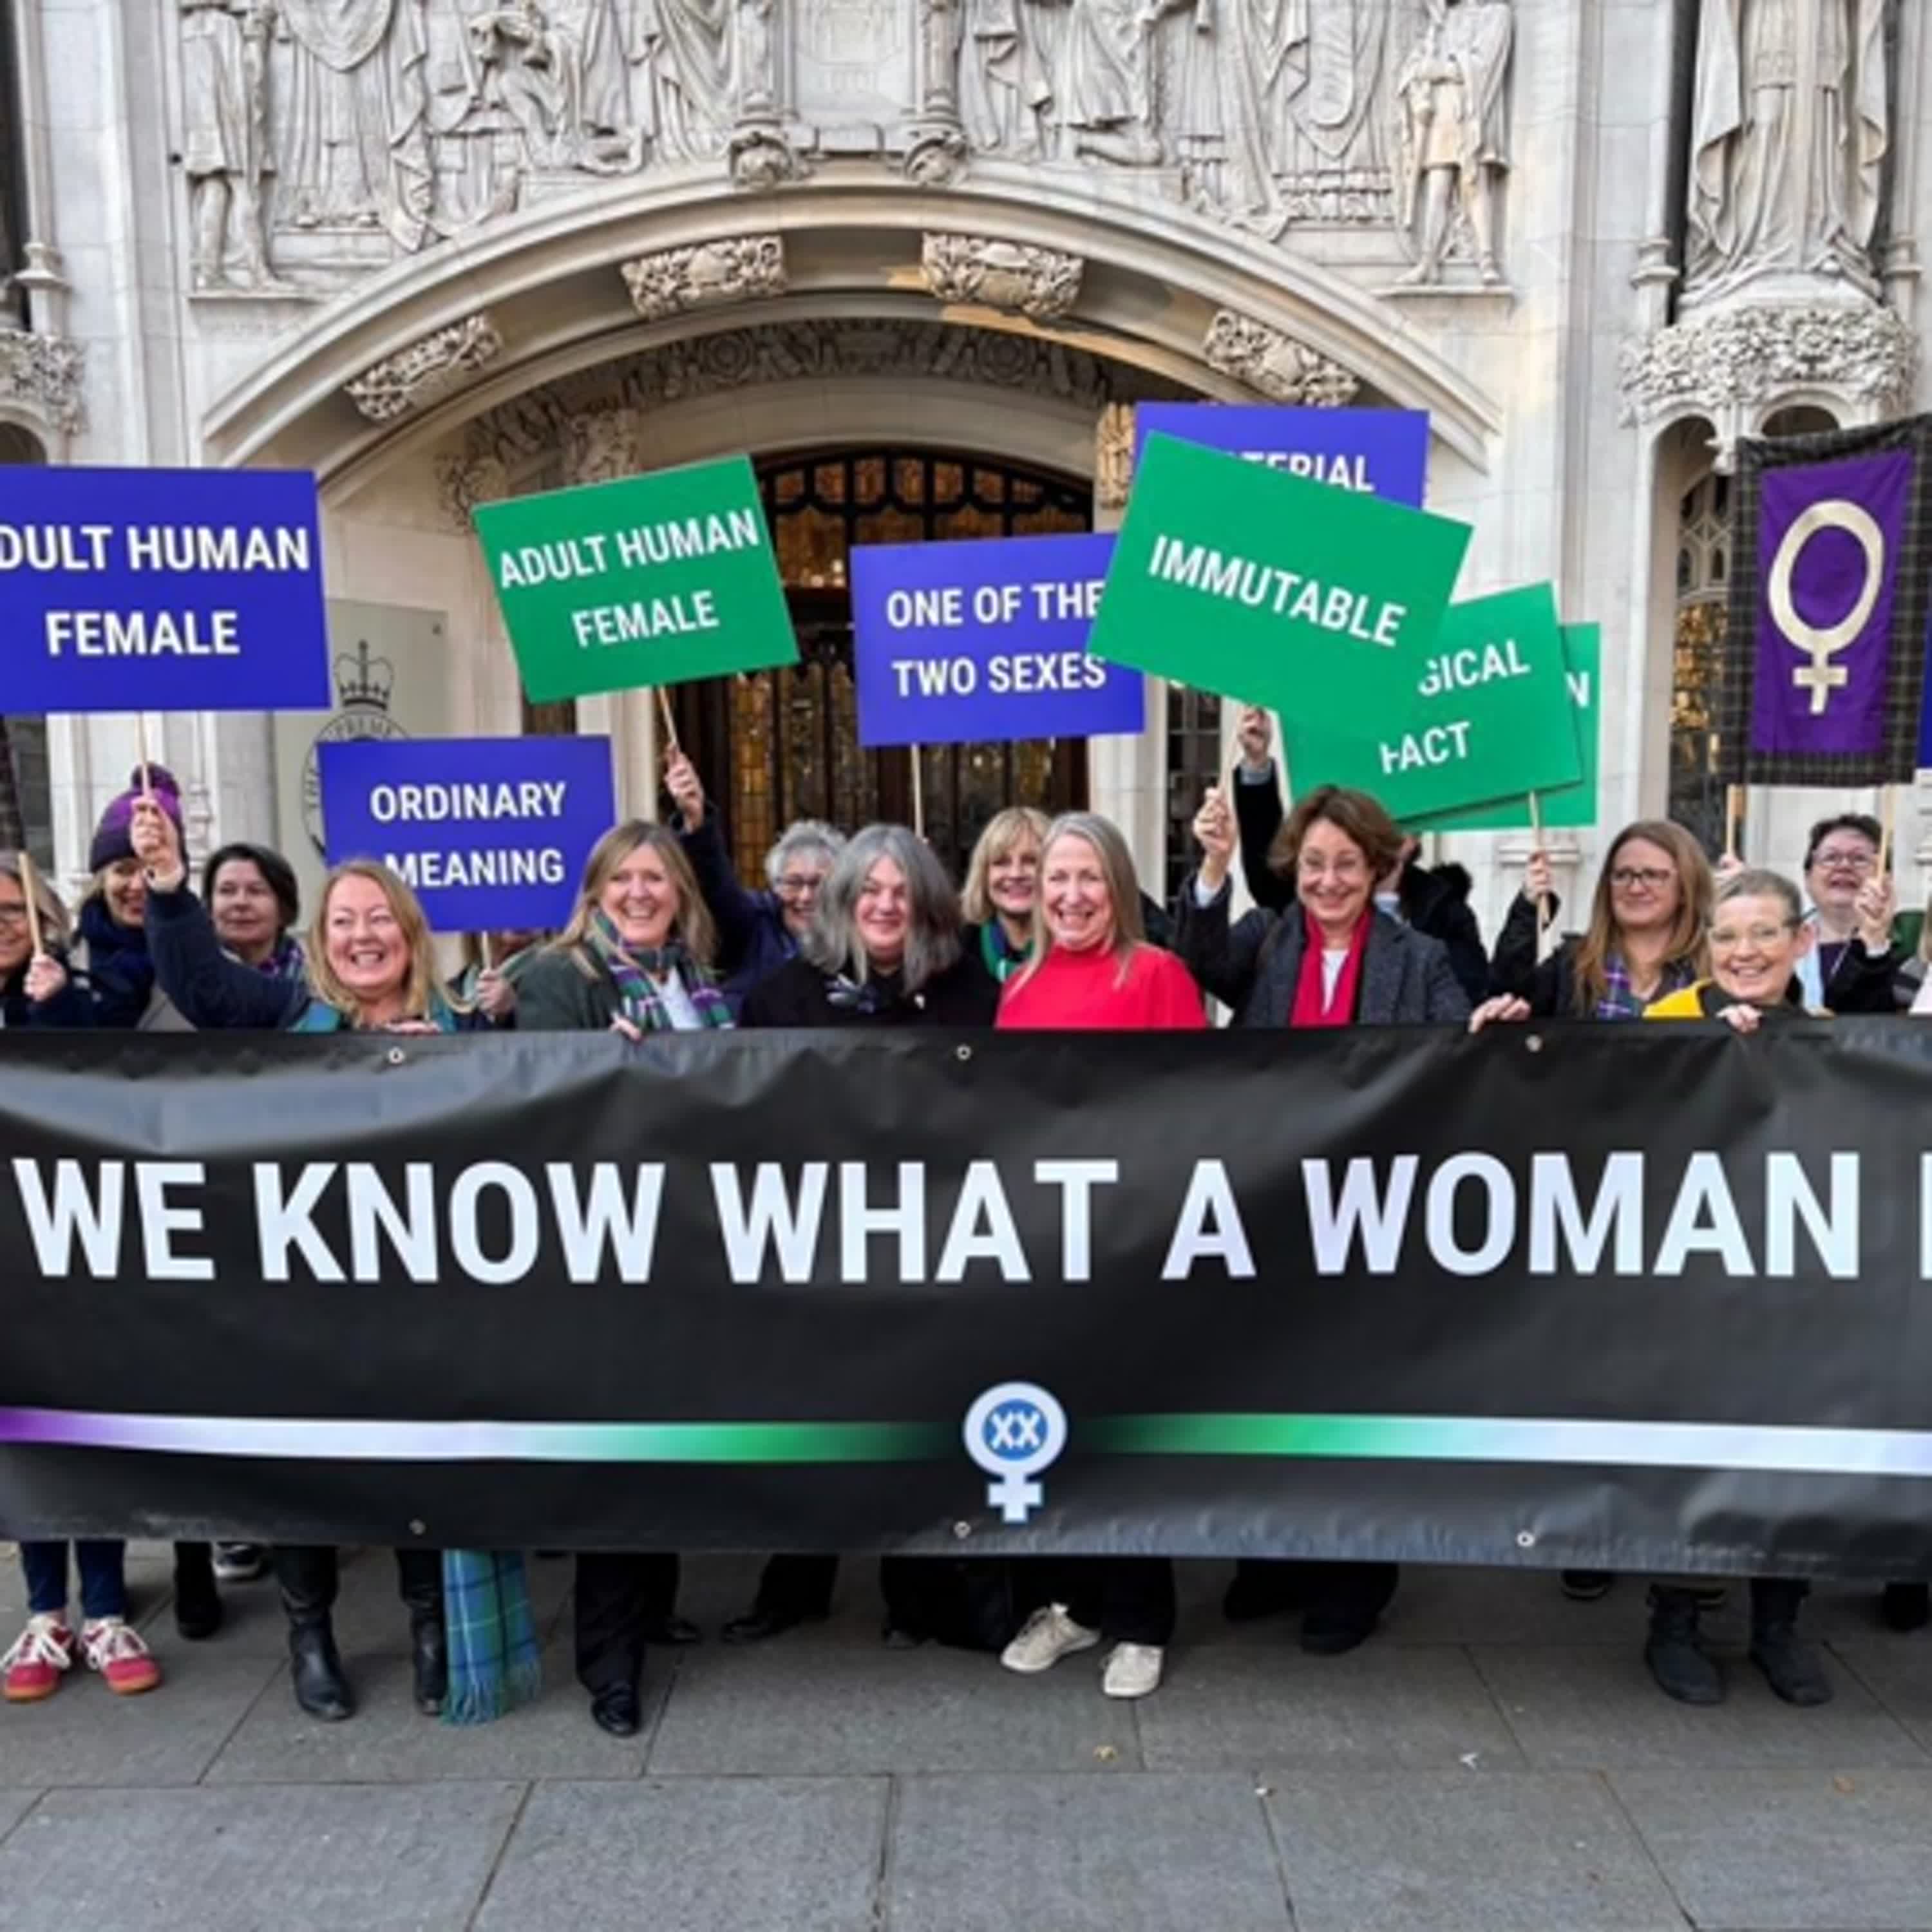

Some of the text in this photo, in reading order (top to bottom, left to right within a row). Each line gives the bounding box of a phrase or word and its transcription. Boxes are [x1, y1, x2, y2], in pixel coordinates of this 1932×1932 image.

[0, 524, 310, 571] DULT HUMAN
[500, 509, 759, 589] ADULT HUMAN
[887, 580, 1105, 629] ONE OF THE
[1149, 535, 1406, 647] IMMUTABLE
[45, 611, 240, 656] FEMALE
[572, 590, 719, 647] FEMALE
[892, 652, 1106, 697] TWO SEXES
[370, 782, 566, 822] ORDINARY
[384, 848, 564, 888] MEANING
[12, 1158, 215, 1280] WE
[253, 1161, 666, 1284] KNOW
[710, 1159, 1119, 1283] WHAT
[1161, 1158, 1256, 1280] A
[1301, 1151, 1861, 1279] WOMAN
[991, 1410, 1041, 1449] XX
